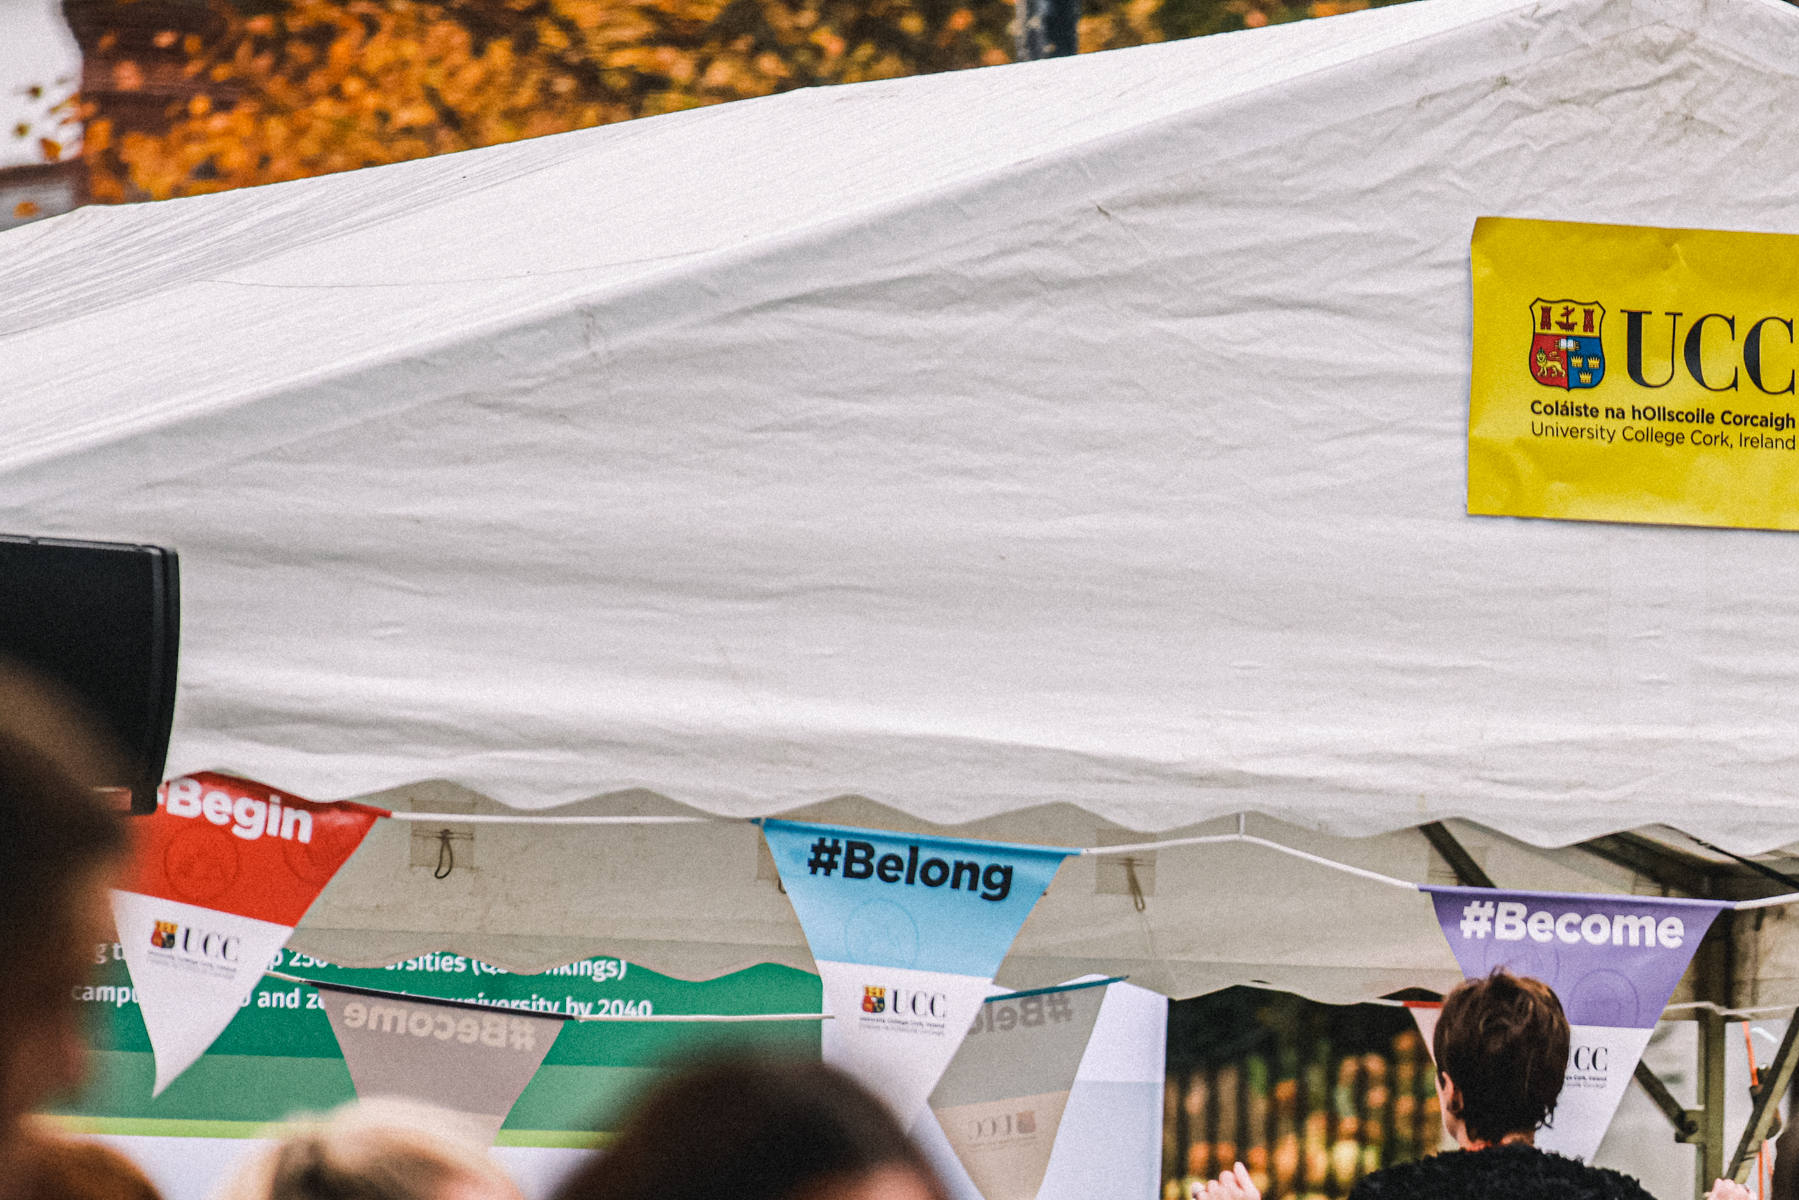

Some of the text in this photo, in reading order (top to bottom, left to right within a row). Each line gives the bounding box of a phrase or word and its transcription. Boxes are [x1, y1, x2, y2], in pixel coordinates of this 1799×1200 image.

[1620, 309, 1795, 395] UCC
[1530, 399, 1796, 431] Coláiste na hOllscoile Corcaigh
[1531, 421, 1796, 450] University College Cork, Ireland
[157, 778, 313, 844] Begin
[807, 836, 1013, 902] #Belong
[1459, 899, 1685, 949] #Become
[184, 927, 240, 962] UCC
[71, 986, 140, 1008] camp
[257, 987, 300, 1010] and
[892, 988, 946, 1018] UCC
